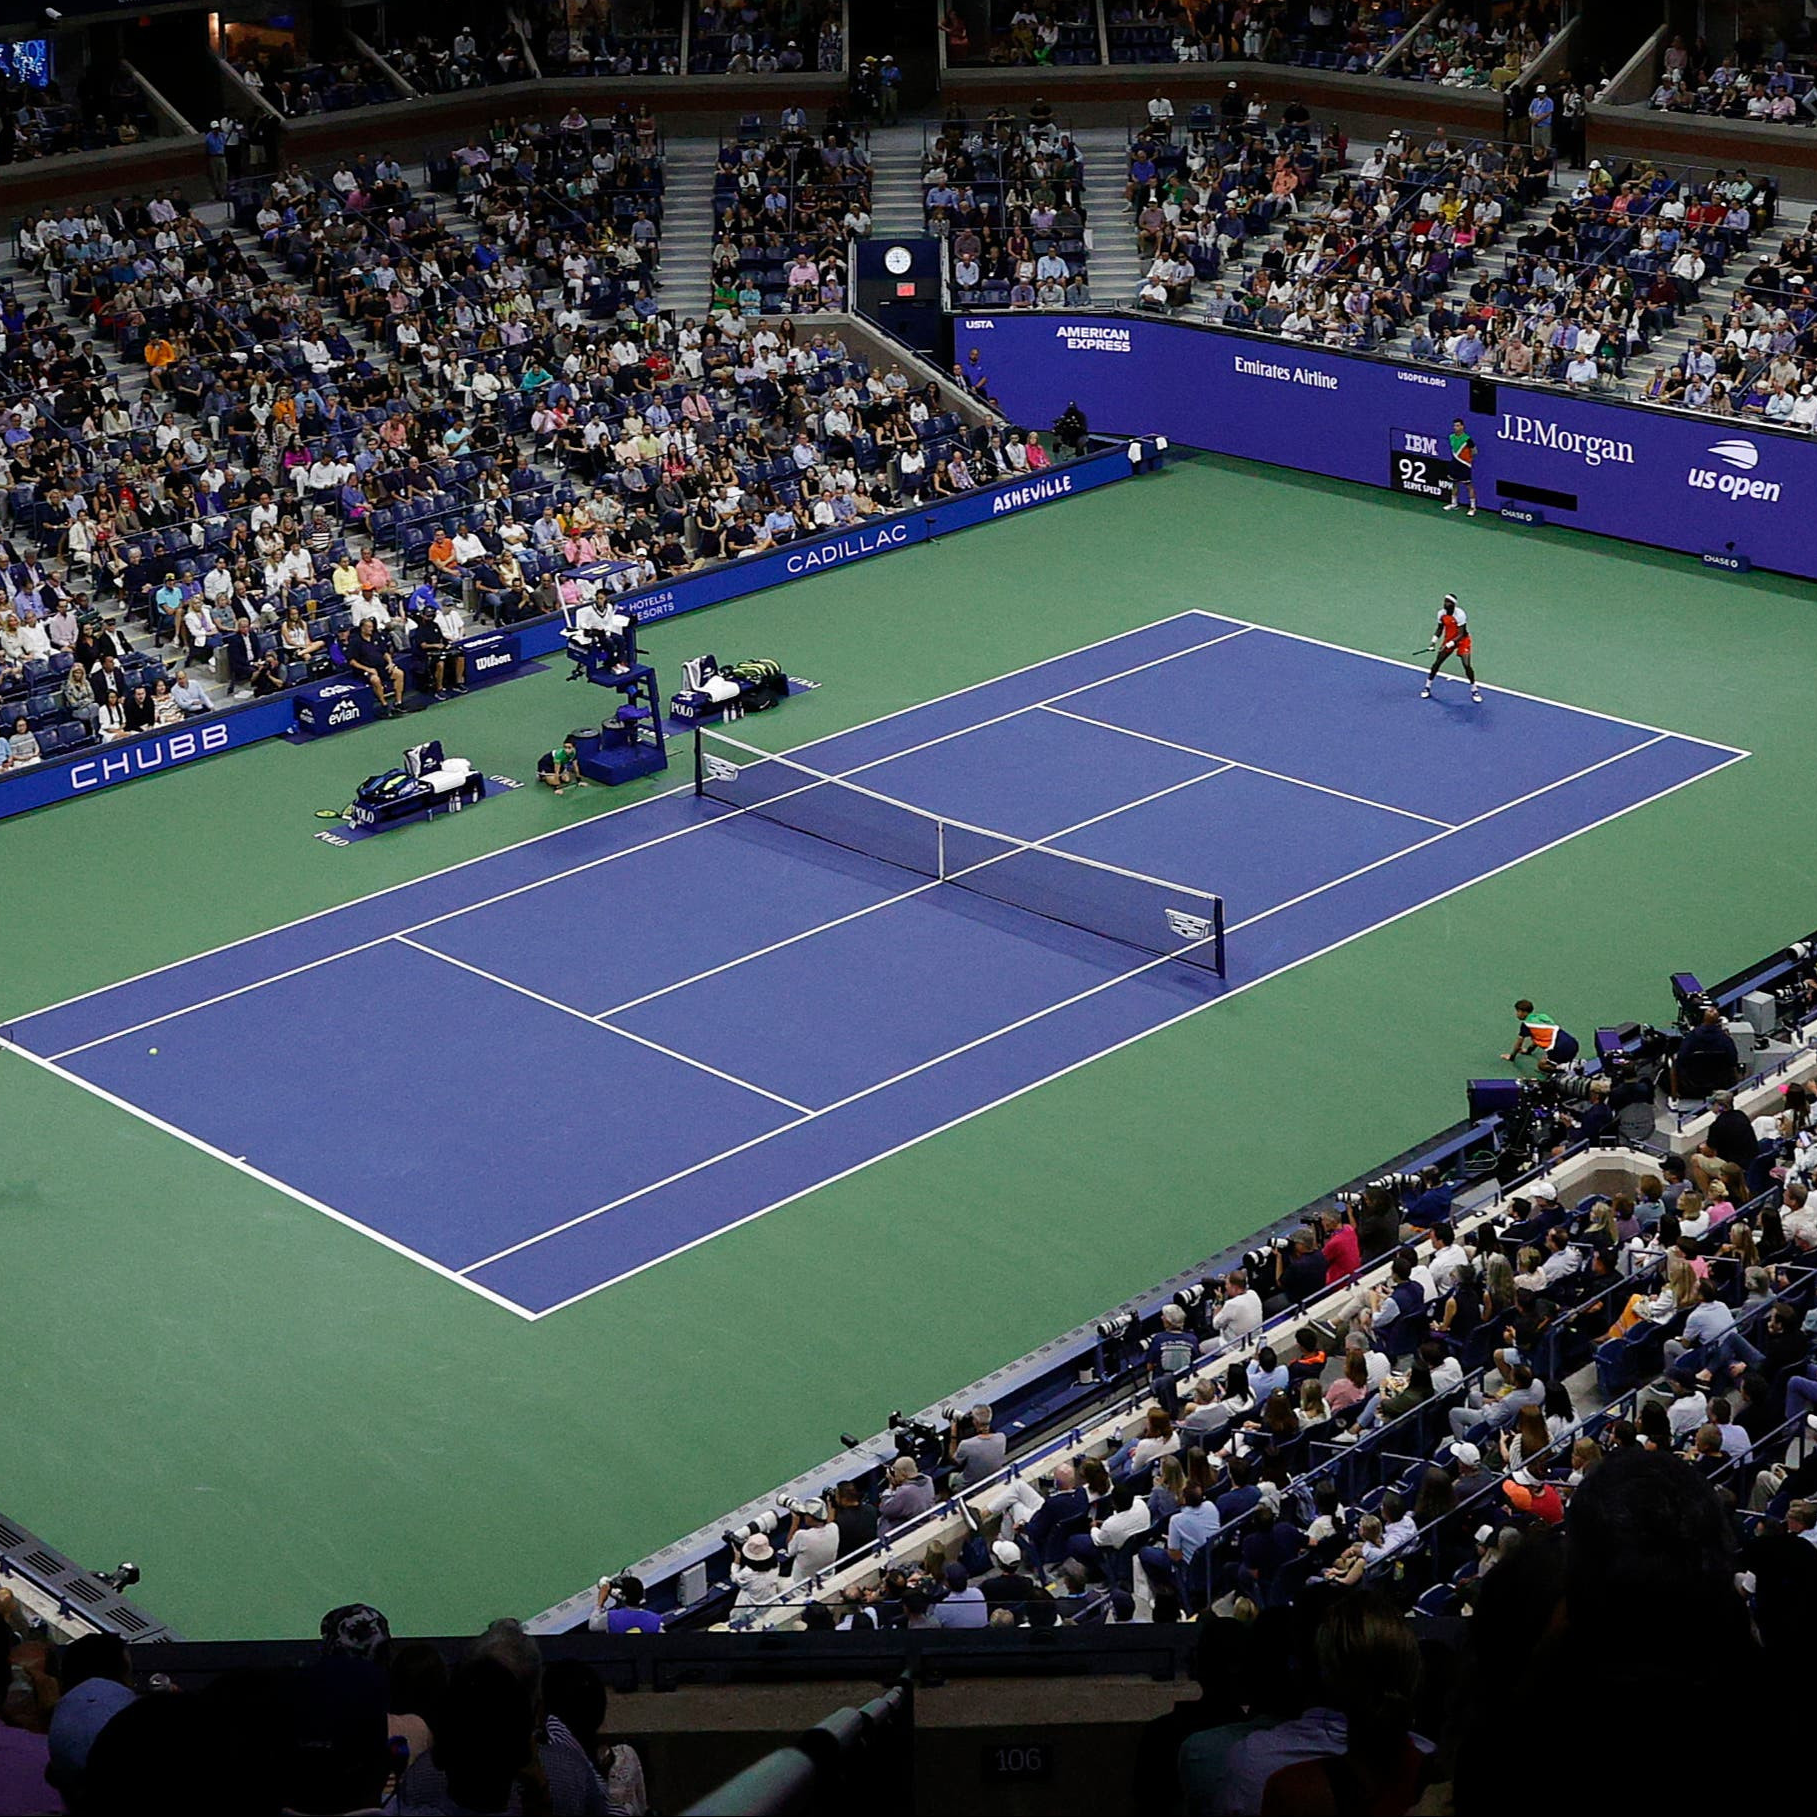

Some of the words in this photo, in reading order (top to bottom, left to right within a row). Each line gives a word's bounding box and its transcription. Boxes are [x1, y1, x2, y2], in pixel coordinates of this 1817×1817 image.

[966, 320, 994, 329] USTA
[1056, 326, 1130, 340] AMERICAN
[1067, 338, 1131, 352] EXPRESS
[1234, 356, 1289, 382] Emirates
[1292, 364, 1339, 390] Airline
[1397, 371, 1447, 387] USOPEN.ORG
[1404, 433, 1438, 456] IBM
[1496, 413, 1635, 467] J.P.Morgan
[1399, 459, 1427, 483] 92
[1687, 466, 1717, 488] us
[1717, 472, 1781, 503] open
[787, 524, 909, 575] CADILLAC
[629, 595, 664, 612] HOTELS
[637, 601, 675, 620] ESORTS
[475, 653, 512, 671] Wilson
[328, 706, 361, 726] evian
[671, 702, 694, 718] POLO
[70, 722, 229, 789] CHUBB
[993, 1747, 1043, 1777] 106
